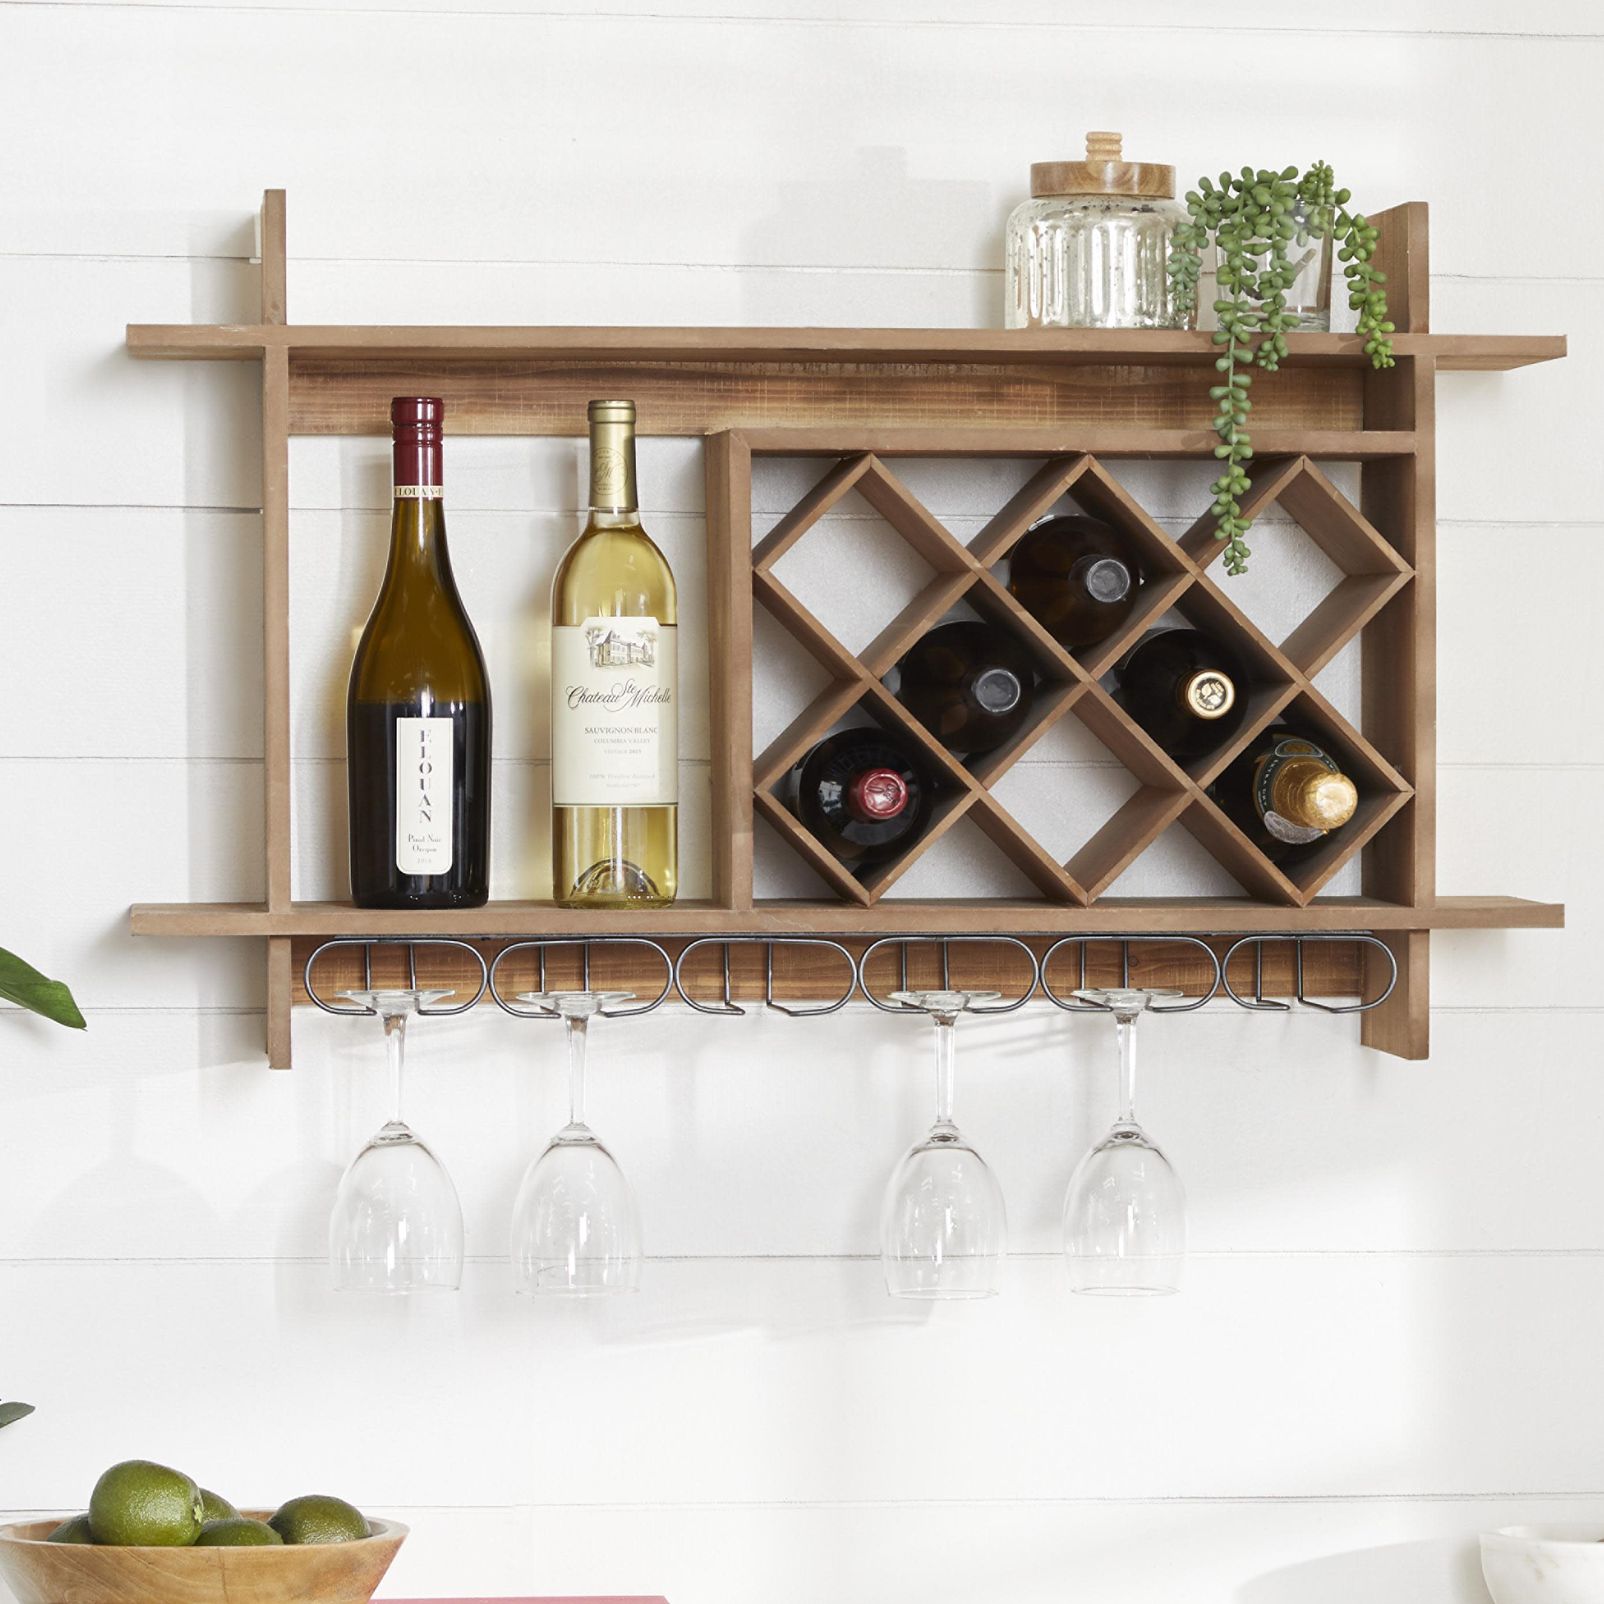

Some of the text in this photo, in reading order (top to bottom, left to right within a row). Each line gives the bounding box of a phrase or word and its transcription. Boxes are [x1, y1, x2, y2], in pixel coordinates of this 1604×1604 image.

[565, 678, 672, 711] Chateau Ste Michelle
[584, 727, 658, 735] SAUVIGNON BLANC
[418, 729, 433, 824] ELOUAN
